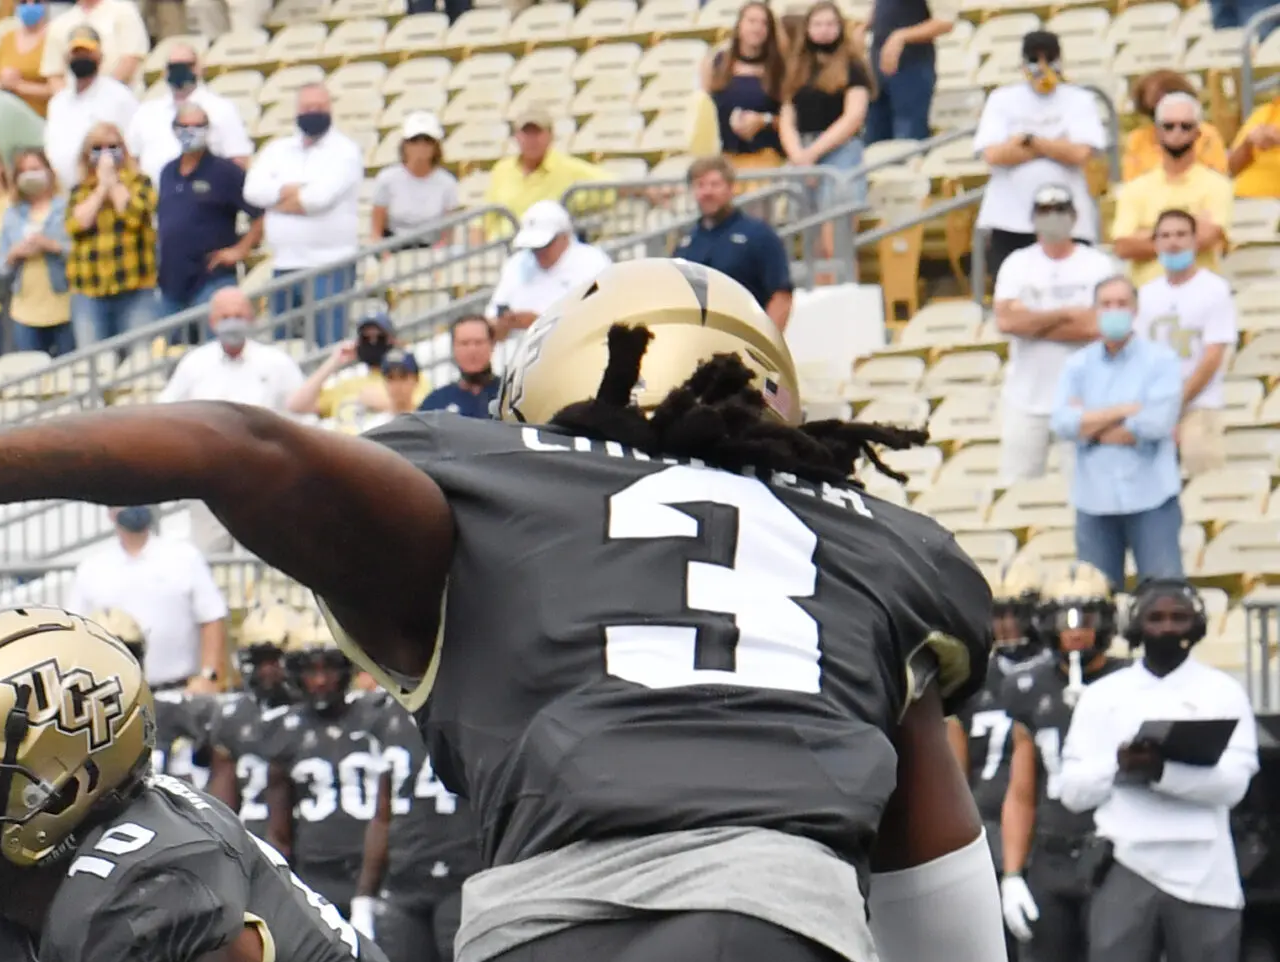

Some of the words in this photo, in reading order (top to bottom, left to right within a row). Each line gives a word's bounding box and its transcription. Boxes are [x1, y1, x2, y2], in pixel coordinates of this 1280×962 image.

[605, 465, 821, 694] 3
[0, 657, 124, 754] UCF
[291, 752, 381, 823] 30
[67, 822, 156, 879] 10
